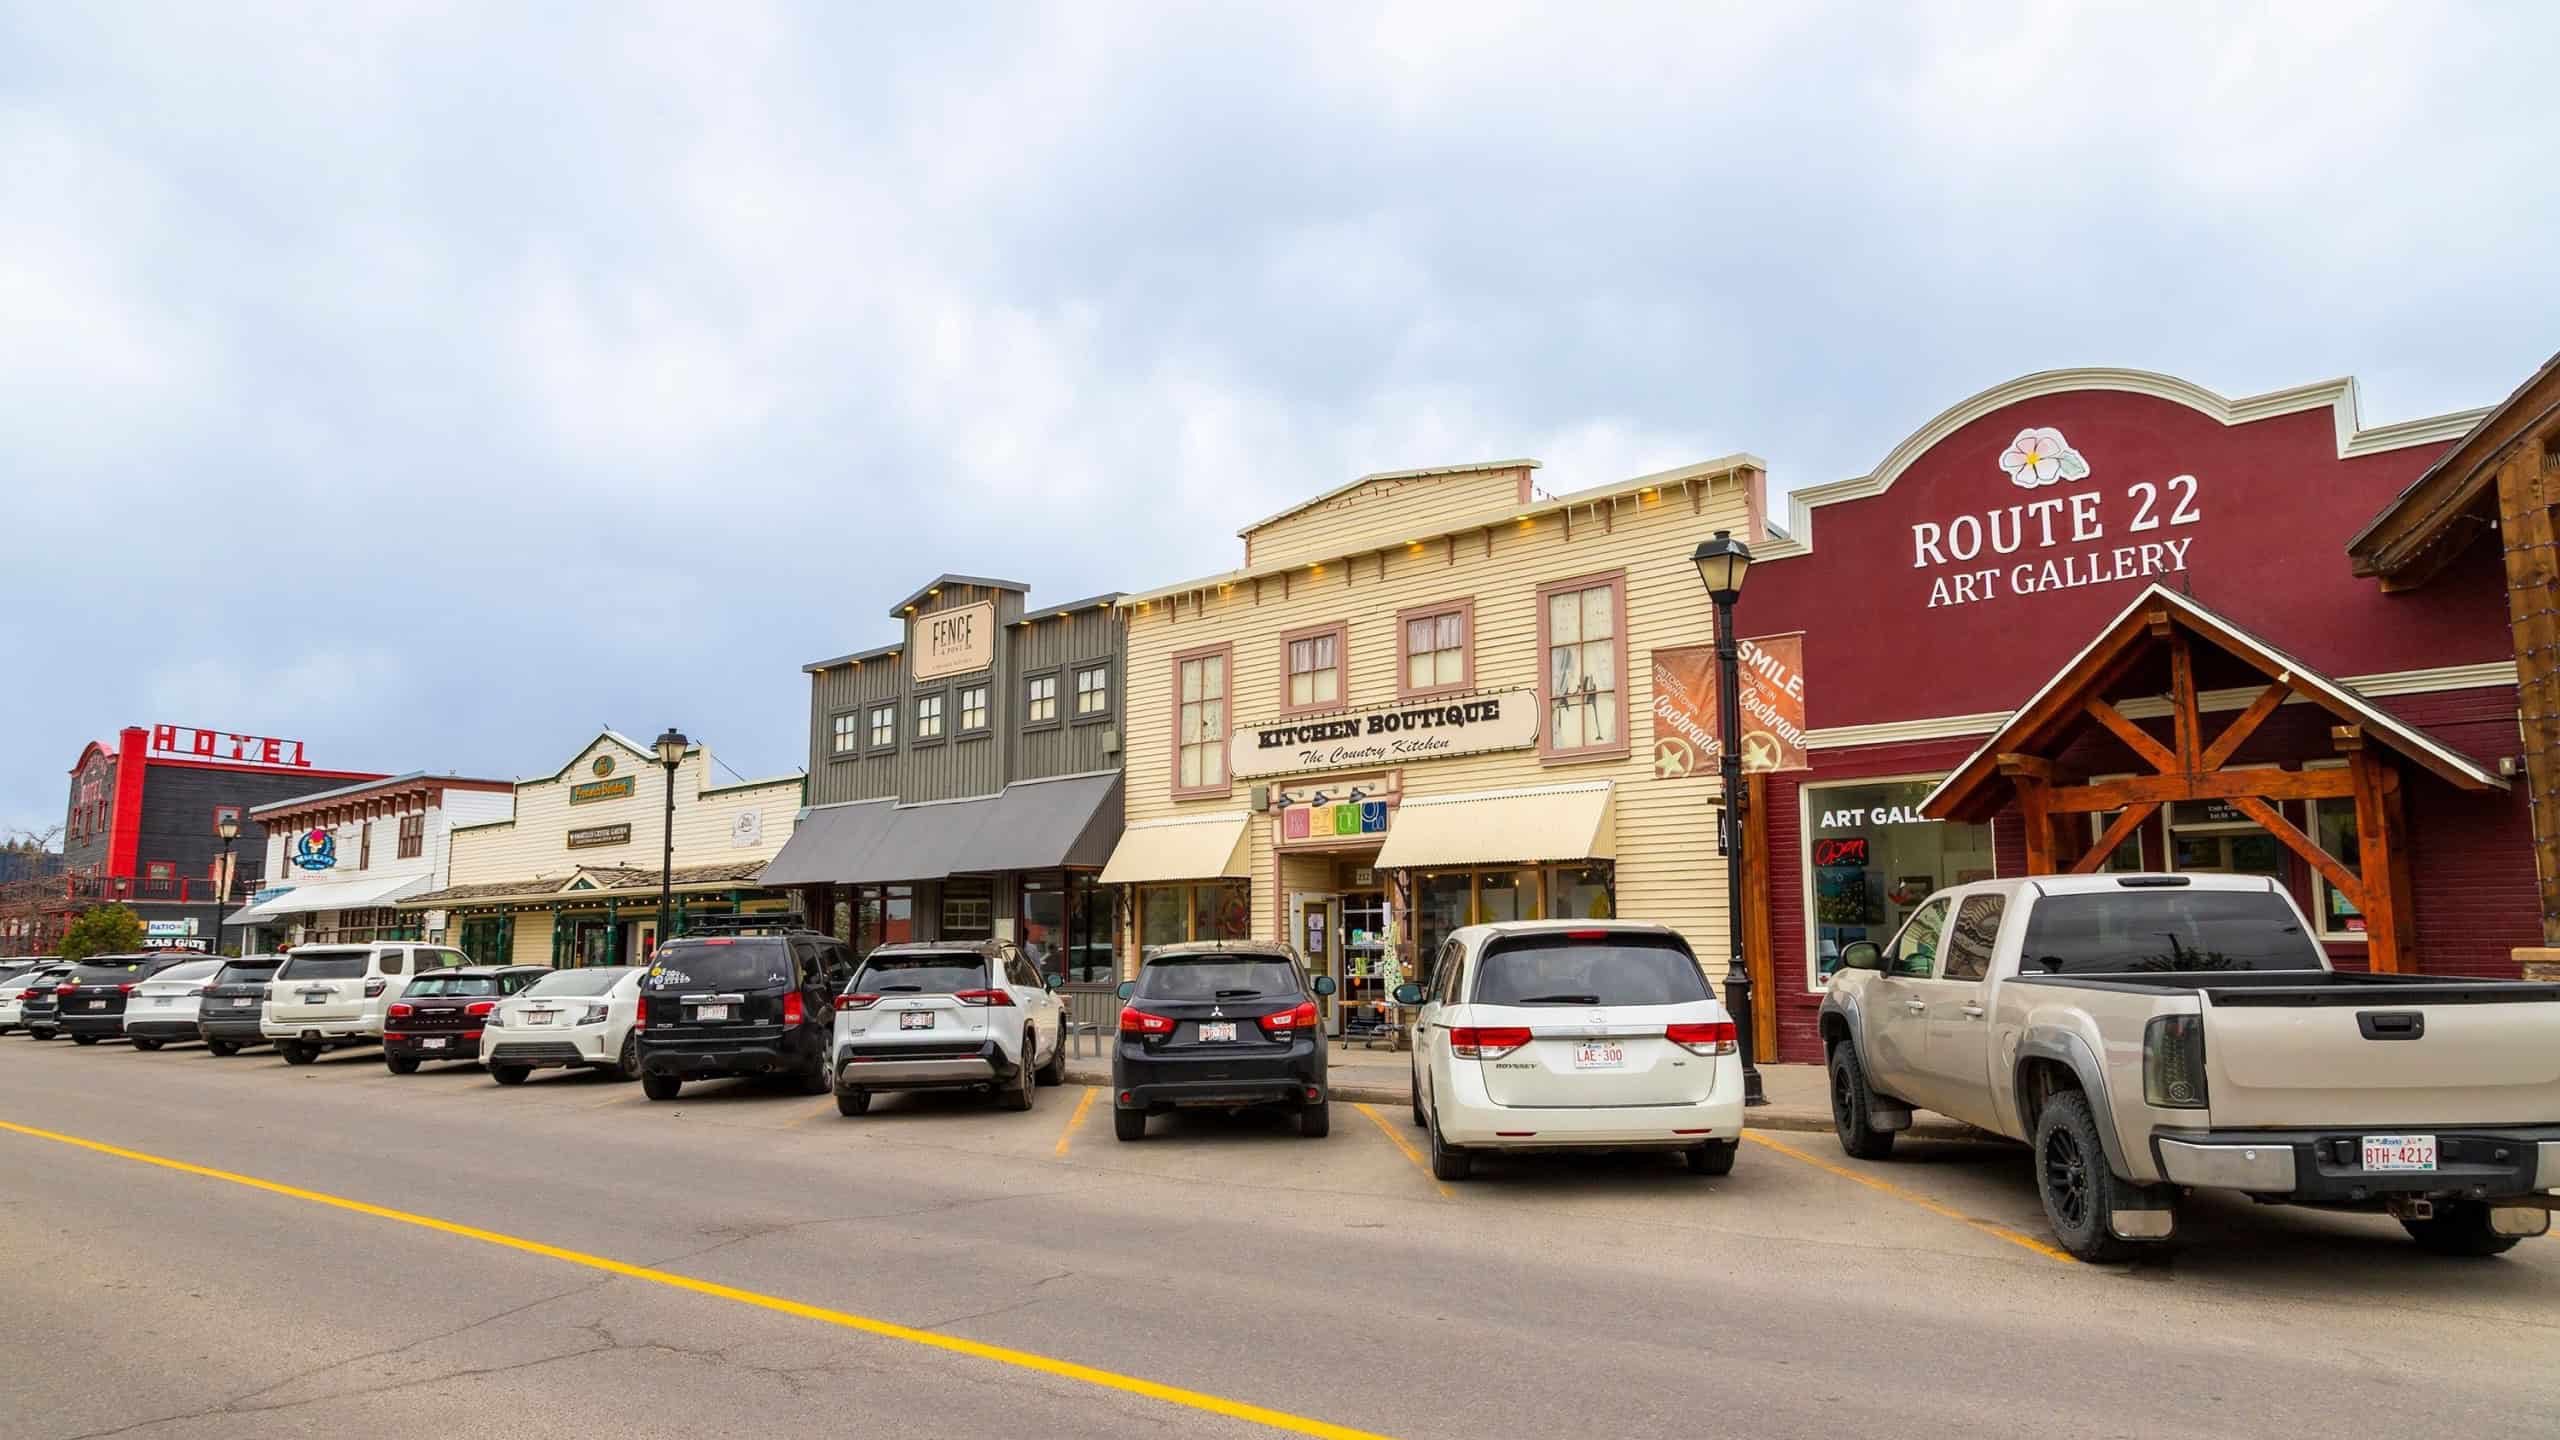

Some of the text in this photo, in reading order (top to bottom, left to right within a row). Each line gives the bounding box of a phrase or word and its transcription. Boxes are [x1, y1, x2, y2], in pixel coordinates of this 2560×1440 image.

[1912, 474, 2201, 569] ROUTE 22
[1927, 537, 2193, 608] ART GALLERY
[932, 614, 973, 657] FENCE
[1737, 640, 1805, 702] SMILE.
[1257, 699, 1501, 749] KITCHEN BOUTIQUE
[1653, 694, 1722, 756] Cochrane
[1739, 687, 1809, 750] Cochrane
[152, 723, 312, 767] HOTEL
[1299, 735, 1450, 766] The Country Kitchen
[1719, 816, 1743, 849] AT
[1820, 805, 1947, 829] ART GAL
[1815, 839, 1865, 865] Open
[143, 938, 173, 948] XAS
[1576, 1049, 1624, 1063] LAE-300
[2365, 1147, 2433, 1164] BTH-4212
